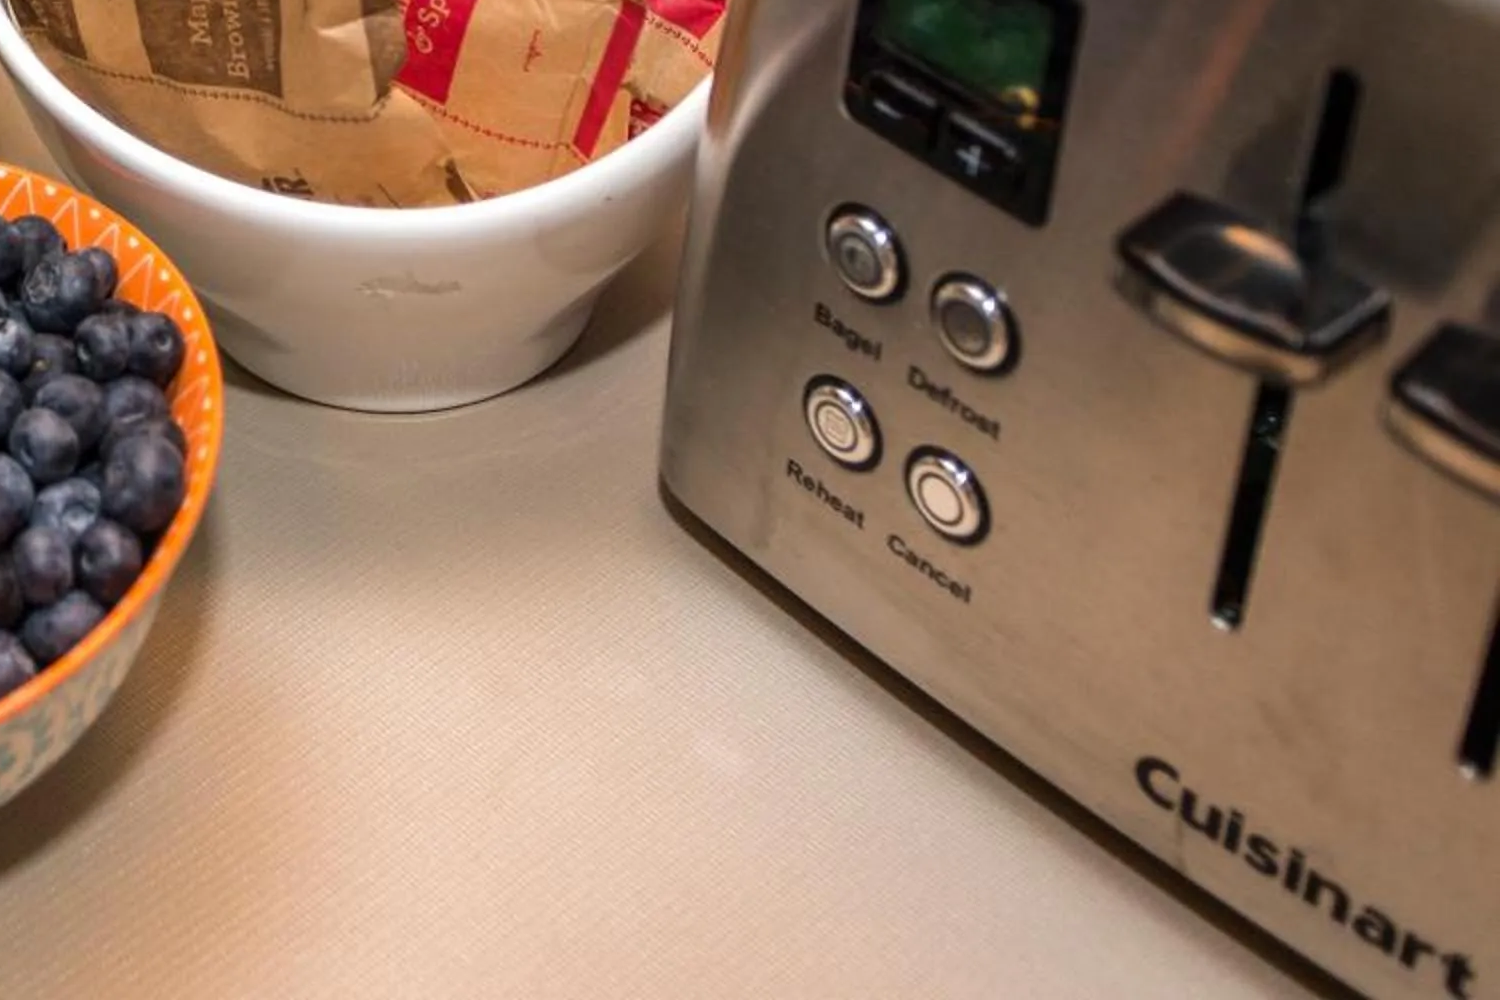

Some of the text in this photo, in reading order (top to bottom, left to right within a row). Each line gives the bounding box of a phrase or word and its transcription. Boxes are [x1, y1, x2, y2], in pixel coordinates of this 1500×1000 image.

[813, 301, 882, 361] Bagel
[907, 364, 1001, 441] Defrost
[786, 457, 865, 530] Reheat
[886, 533, 972, 604] Cancel
[1133, 755, 1477, 1000] Cuisinart
